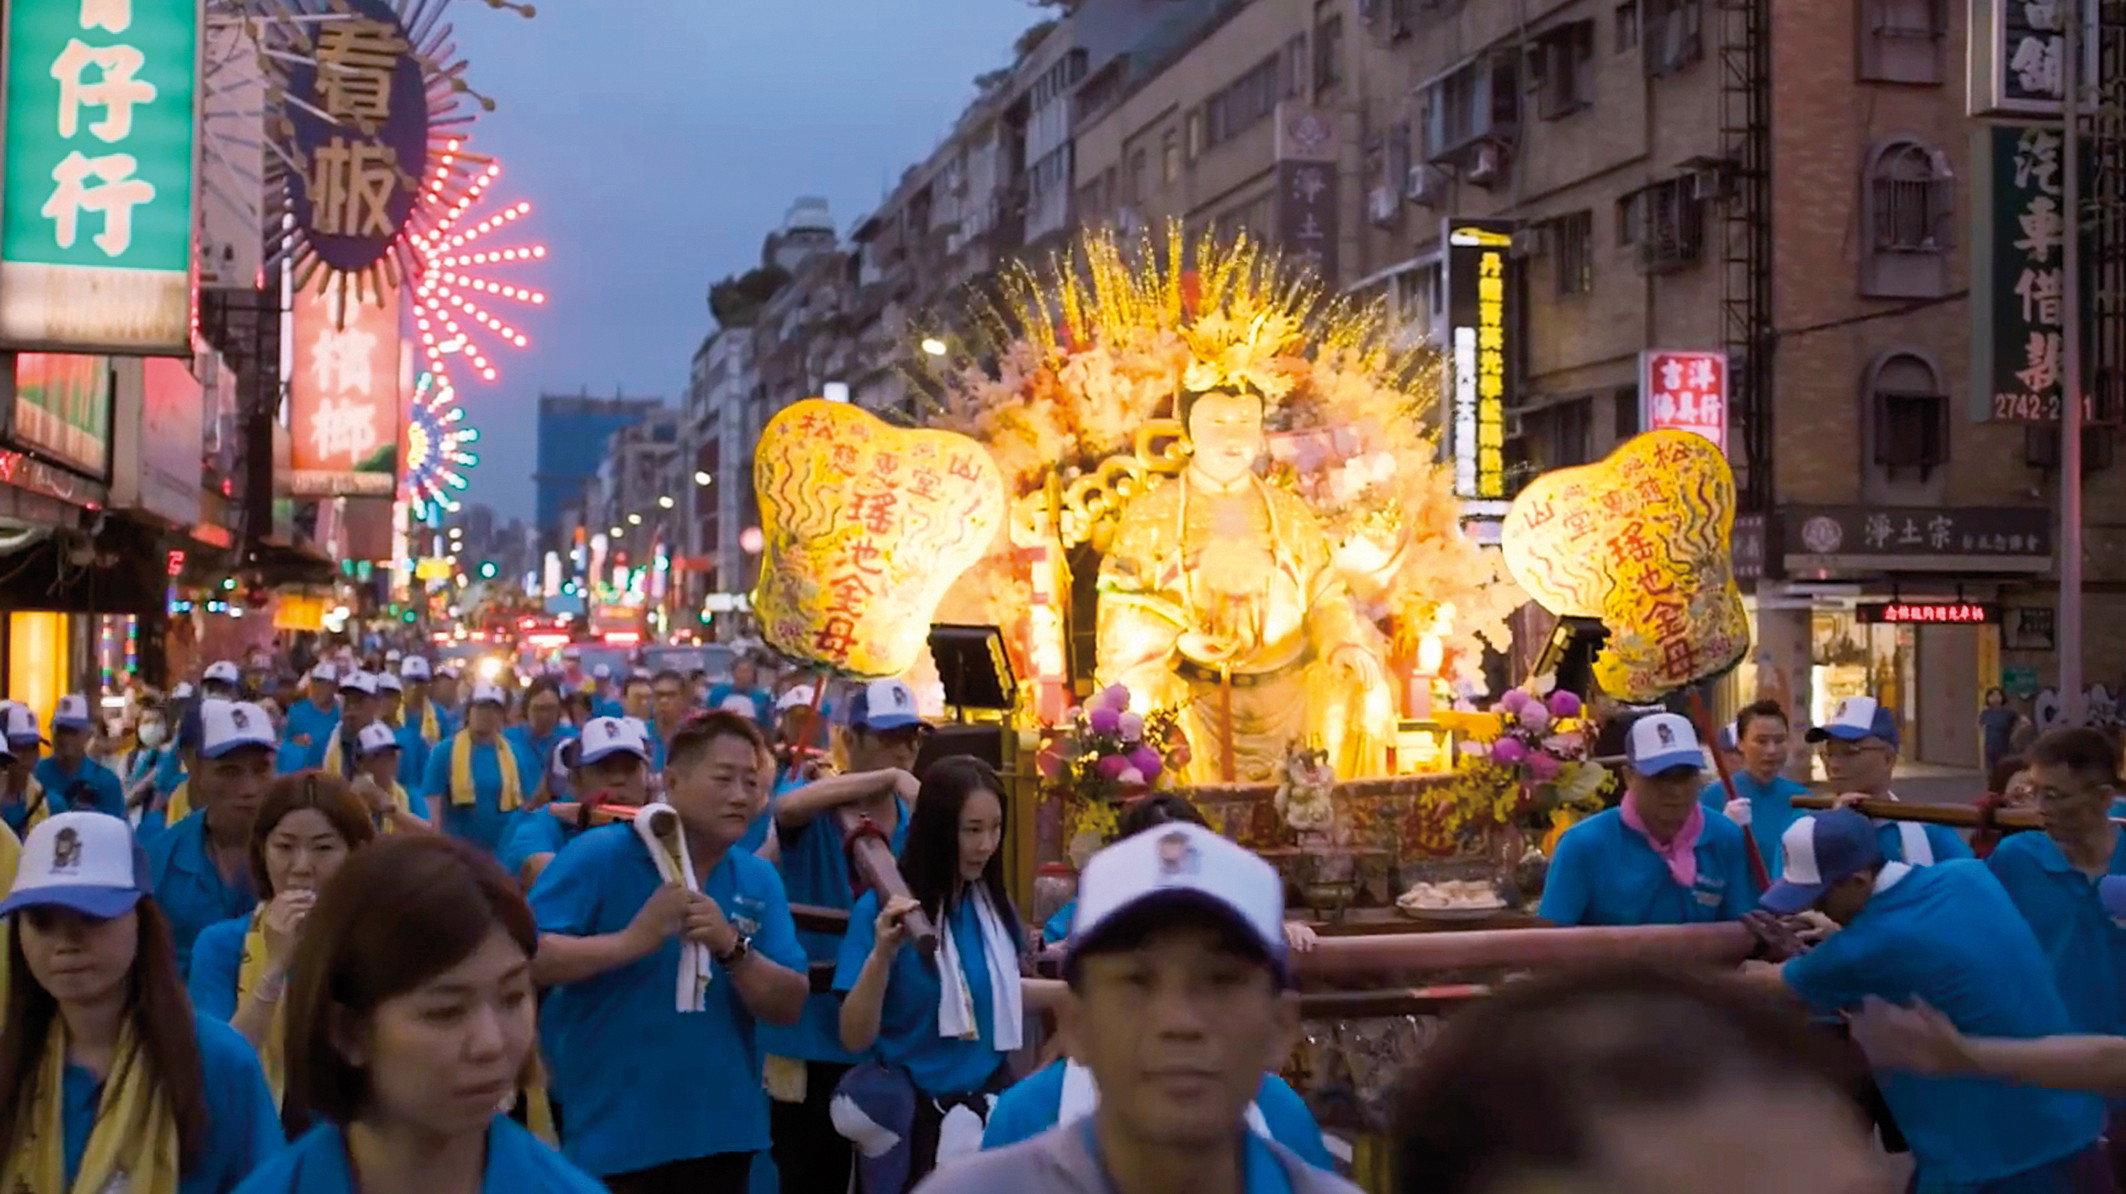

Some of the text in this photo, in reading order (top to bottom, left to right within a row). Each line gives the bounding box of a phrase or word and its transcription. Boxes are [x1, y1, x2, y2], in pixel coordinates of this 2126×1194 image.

[41, 0, 157, 257] 仔行
[311, 272, 376, 465] 檳榔
[1995, 393, 2092, 420] 2742-21
[1607, 521, 1699, 681] 瑤池金母
[1864, 513, 1953, 549] 淨土宗
